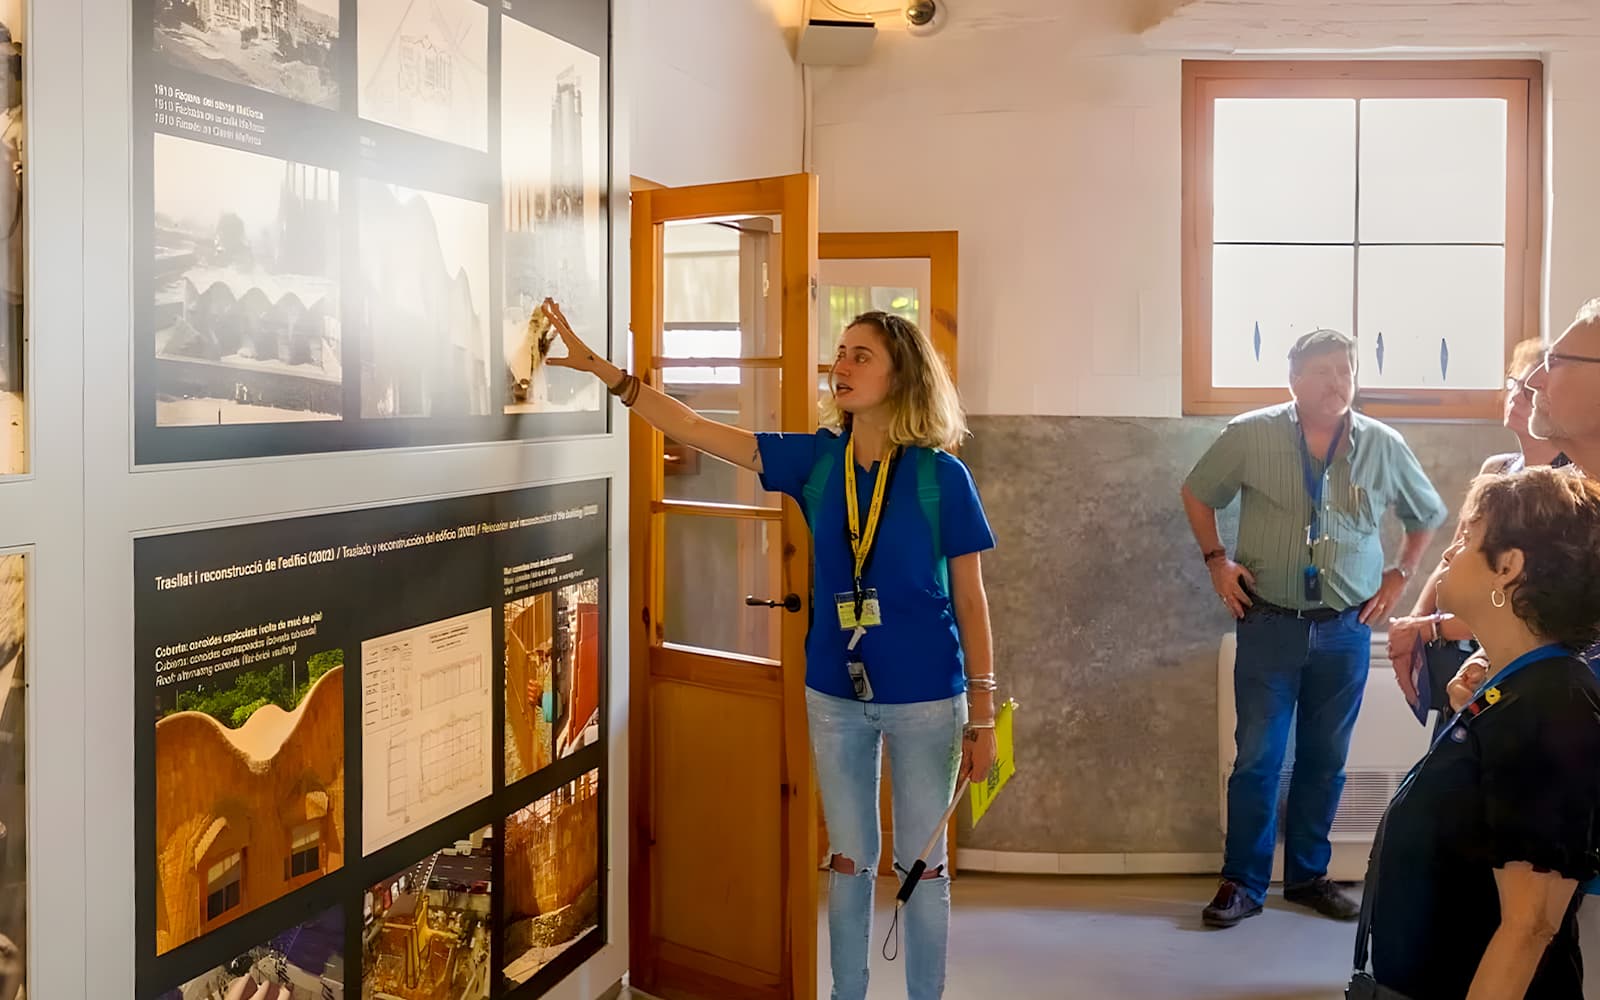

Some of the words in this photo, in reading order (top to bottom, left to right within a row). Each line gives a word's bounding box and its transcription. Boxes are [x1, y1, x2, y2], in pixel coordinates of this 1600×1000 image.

[154, 84, 173, 97] 1910
[154, 98, 174, 112] 1910
[154, 113, 174, 126] 1910
[155, 571, 193, 591] Trasllat
[195, 570, 198, 584] i
[200, 560, 263, 583] reconstrucció
[265, 558, 276, 572] de
[308, 548, 335, 564] (2002)
[342, 542, 371, 558] Traslado
[372, 544, 377, 556] y
[377, 534, 424, 552] reconstrucción
[436, 528, 456, 542] edificio
